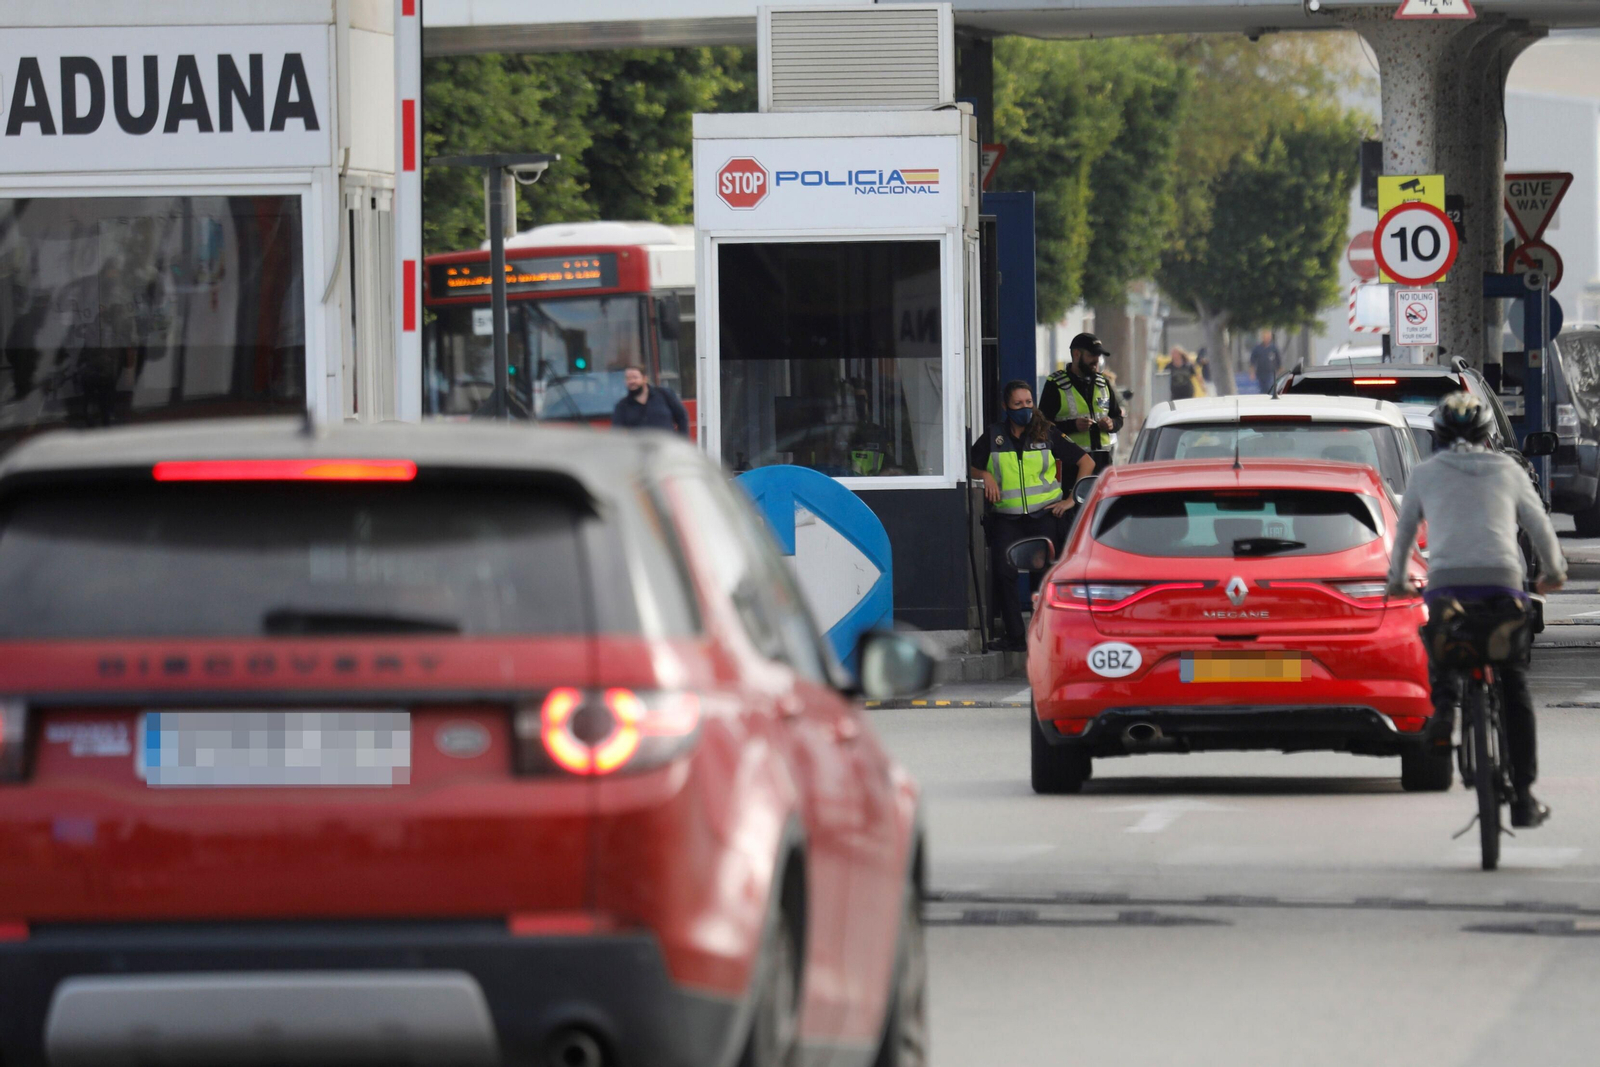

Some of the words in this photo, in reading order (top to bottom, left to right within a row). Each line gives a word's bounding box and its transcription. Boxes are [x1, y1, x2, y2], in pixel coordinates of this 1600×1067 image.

[5, 52, 320, 136] ADUANA
[721, 171, 765, 195] STOP
[854, 185, 940, 195] NACIONAL
[1509, 181, 1553, 197] GIVE
[1517, 199, 1549, 211] WAY
[1390, 225, 1441, 262] 10
[1092, 650, 1134, 670] GBZ
